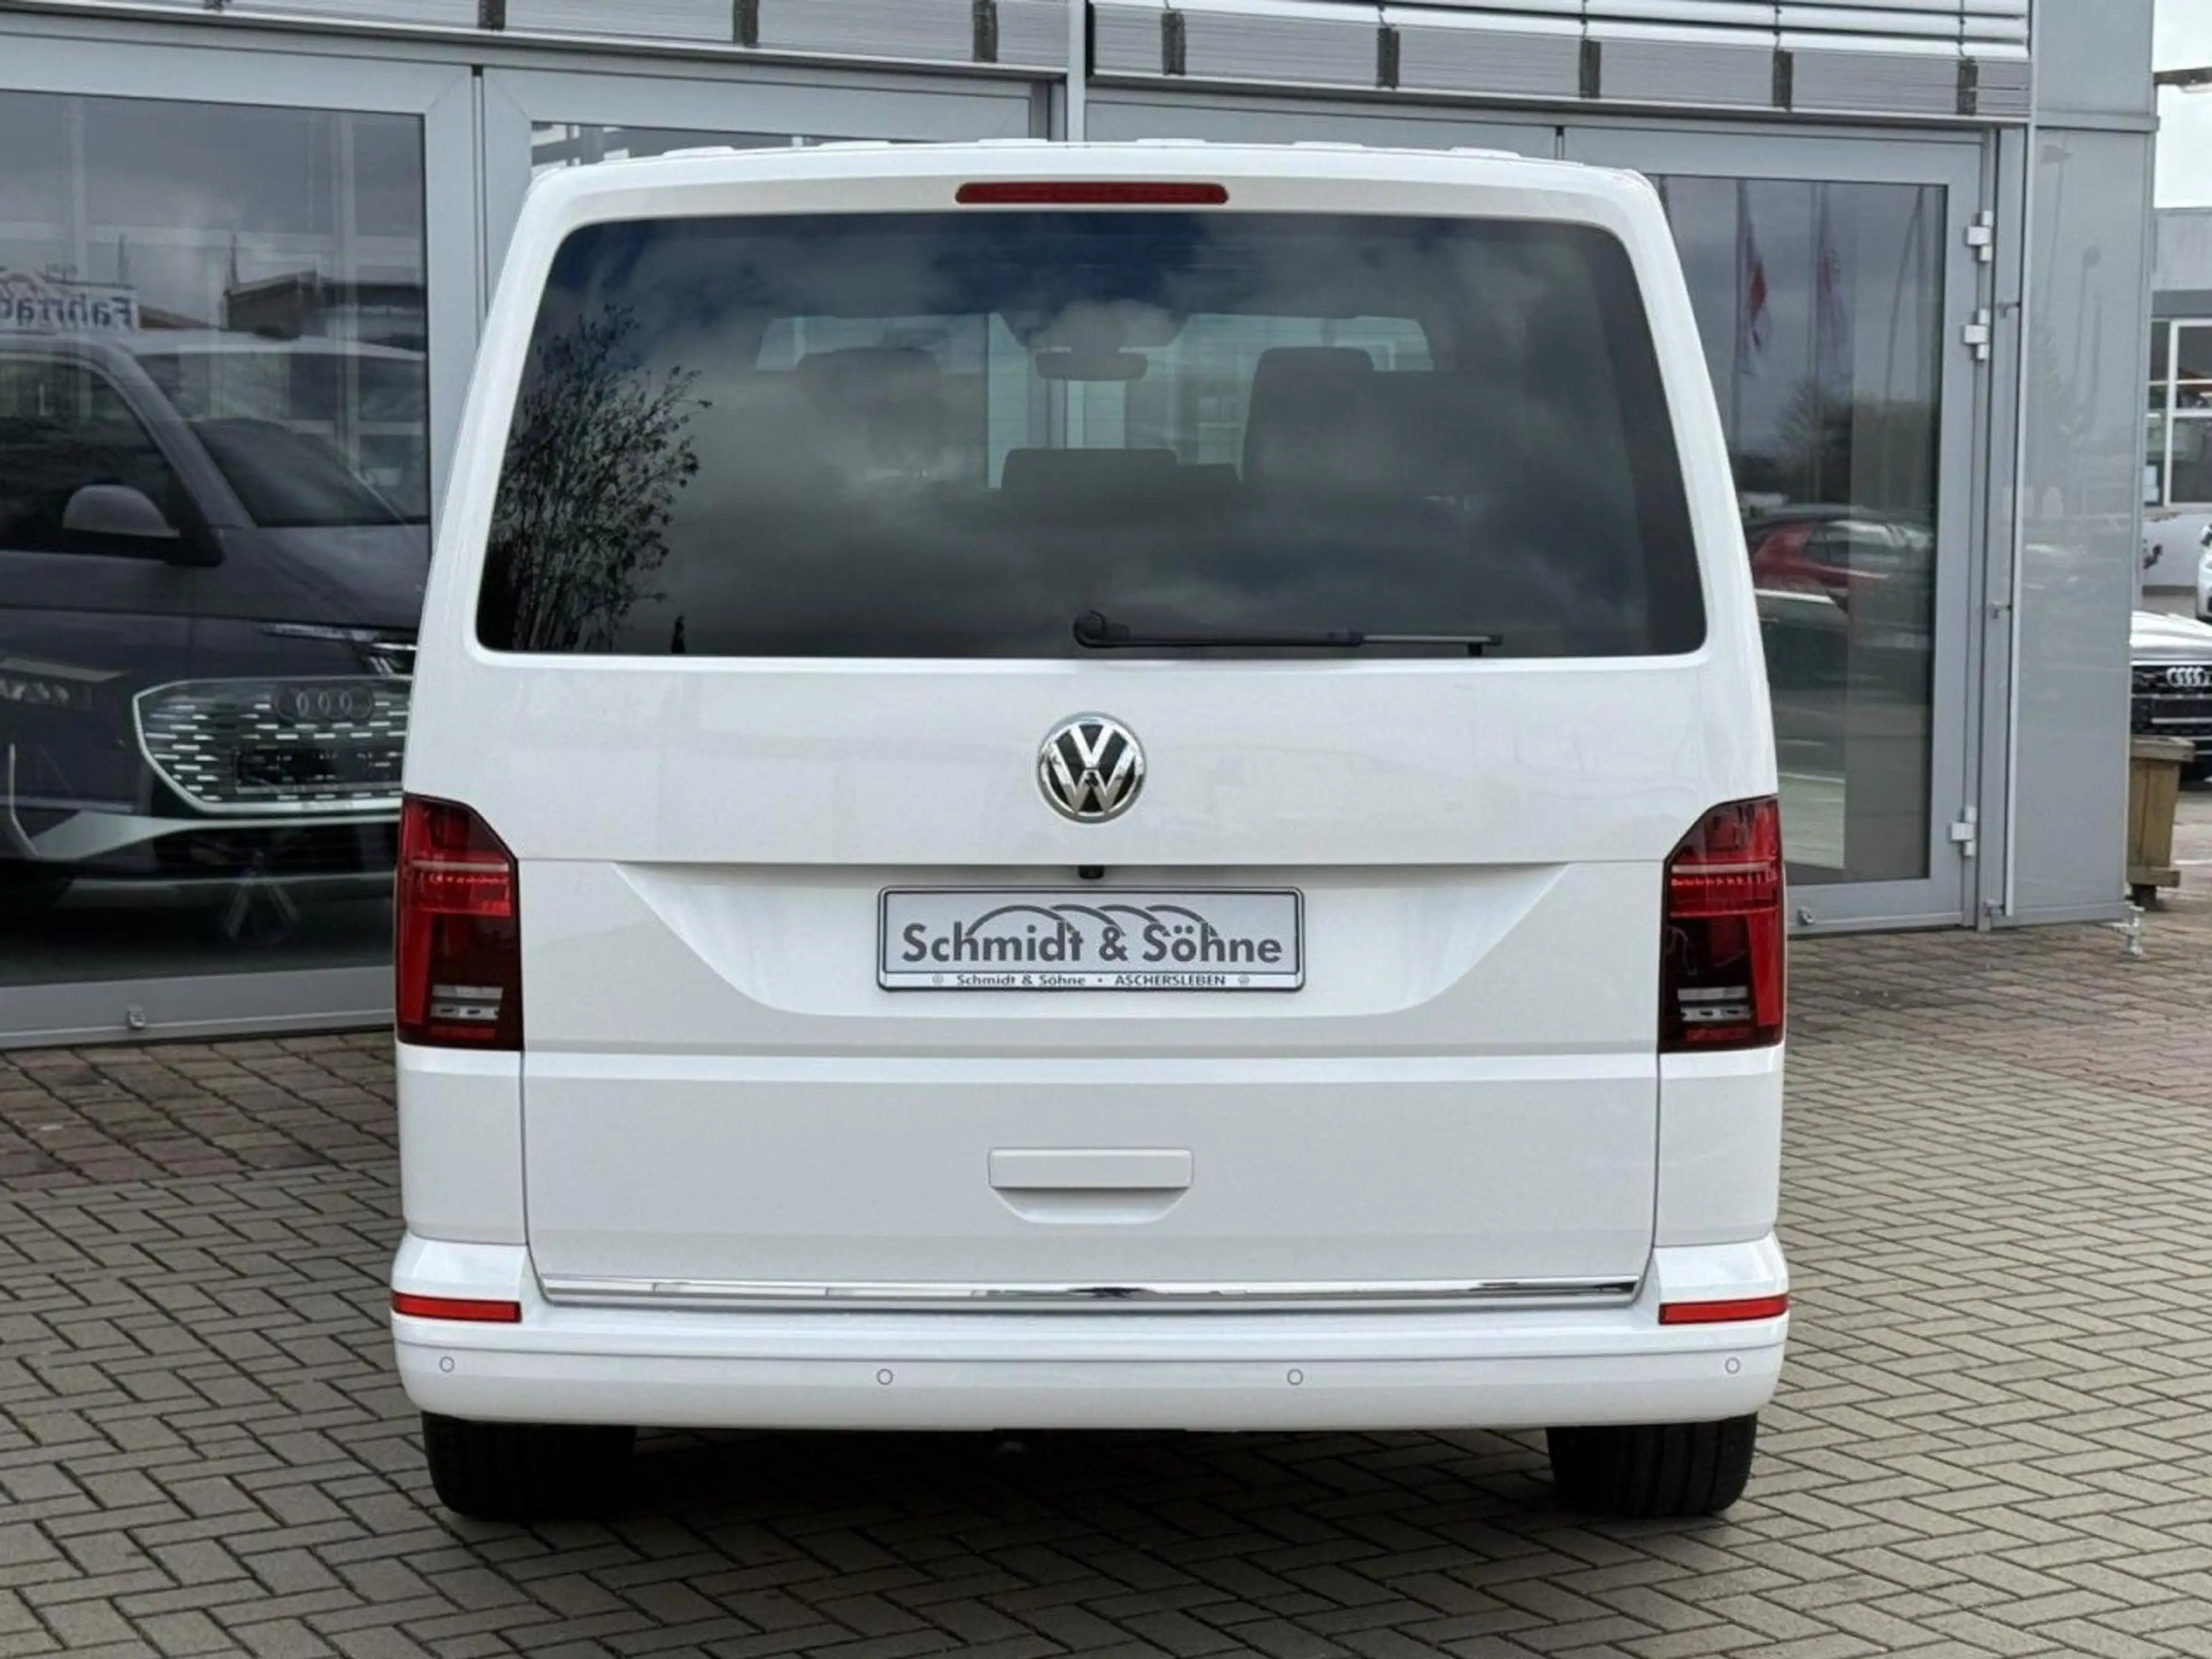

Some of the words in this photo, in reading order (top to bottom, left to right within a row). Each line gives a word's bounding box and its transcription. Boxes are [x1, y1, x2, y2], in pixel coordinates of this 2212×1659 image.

[902, 921, 1083, 961] Schmidt
[1099, 926, 1127, 961] &
[1142, 922, 1282, 963] Söhne
[957, 974, 1016, 985] Schmidt
[1021, 974, 1033, 985] &
[1115, 974, 1226, 986] ASCHERSLEBEN
